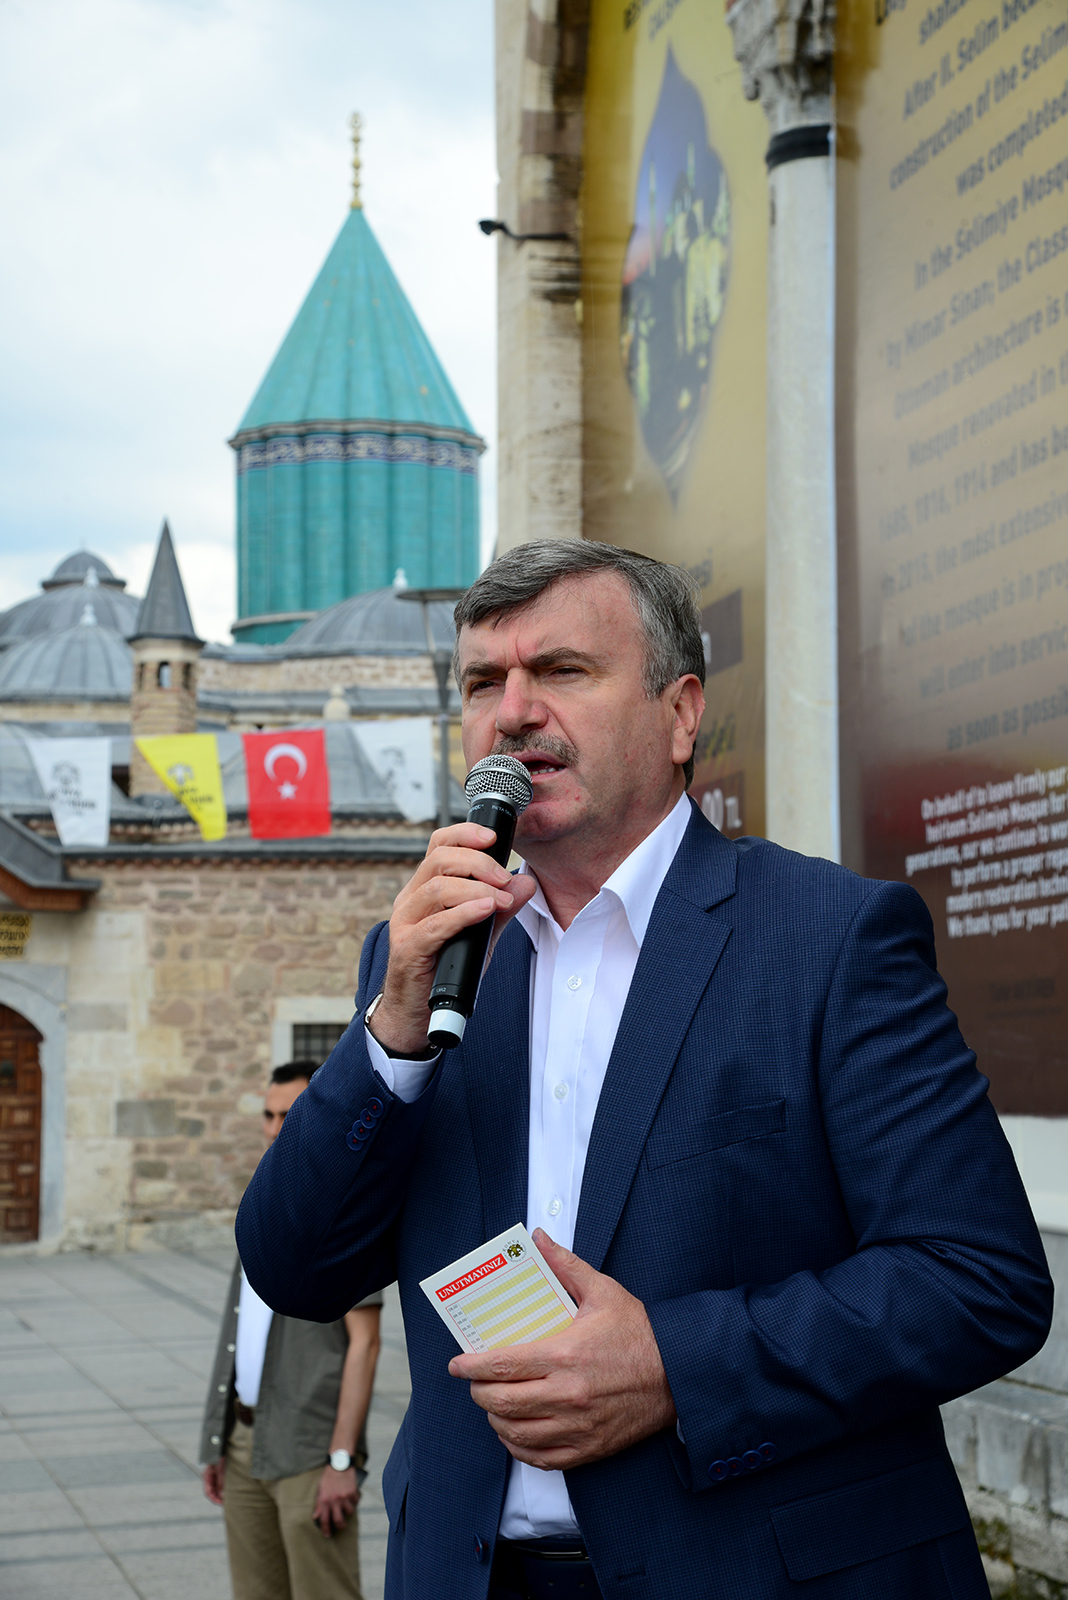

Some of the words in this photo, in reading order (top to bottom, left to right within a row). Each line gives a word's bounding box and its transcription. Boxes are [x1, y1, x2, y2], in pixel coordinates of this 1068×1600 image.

[903, 70, 937, 122] After
[957, 15, 999, 72] Selim
[889, 103, 973, 191] construction
[976, 79, 991, 119] of
[994, 64, 1019, 104] the
[957, 156, 985, 197] was
[931, 245, 953, 278] the
[956, 195, 1018, 262] Selimiye
[998, 257, 1022, 294] the
[953, 310, 1042, 386] architecture
[1046, 294, 1060, 328] is
[962, 368, 1037, 441] renovated
[1040, 364, 1056, 397] in
[991, 444, 1017, 487] and
[1020, 436, 1047, 472] has
[935, 545, 958, 575] the
[961, 522, 996, 564] most
[919, 612, 941, 642] the
[944, 588, 998, 631] mosque
[1002, 577, 1016, 607] is
[1018, 570, 1033, 600] in
[947, 655, 985, 690] enter
[988, 642, 1017, 675] into
[947, 724, 963, 751] as
[966, 713, 999, 746] soon
[1002, 707, 1019, 735] as
[934, 788, 966, 817] behalf
[986, 781, 1014, 804] leave
[1014, 768, 1046, 795] firmly
[967, 806, 1009, 834] Selimiye
[1009, 798, 1049, 825] Mosque
[1049, 790, 1065, 815] for
[980, 837, 995, 858] we
[995, 827, 1037, 853] continue
[1037, 821, 1049, 844] to
[946, 890, 983, 914] modern
[983, 878, 1038, 908] restoration
[962, 860, 1002, 893] perform
[1010, 852, 1044, 881] proper
[946, 915, 963, 938] We
[963, 911, 990, 936] thank
[990, 912, 1009, 937] you
[1009, 905, 1025, 930] for
[1025, 904, 1049, 932] your
[438, 1256, 504, 1299] UNUTMAYINIZ
